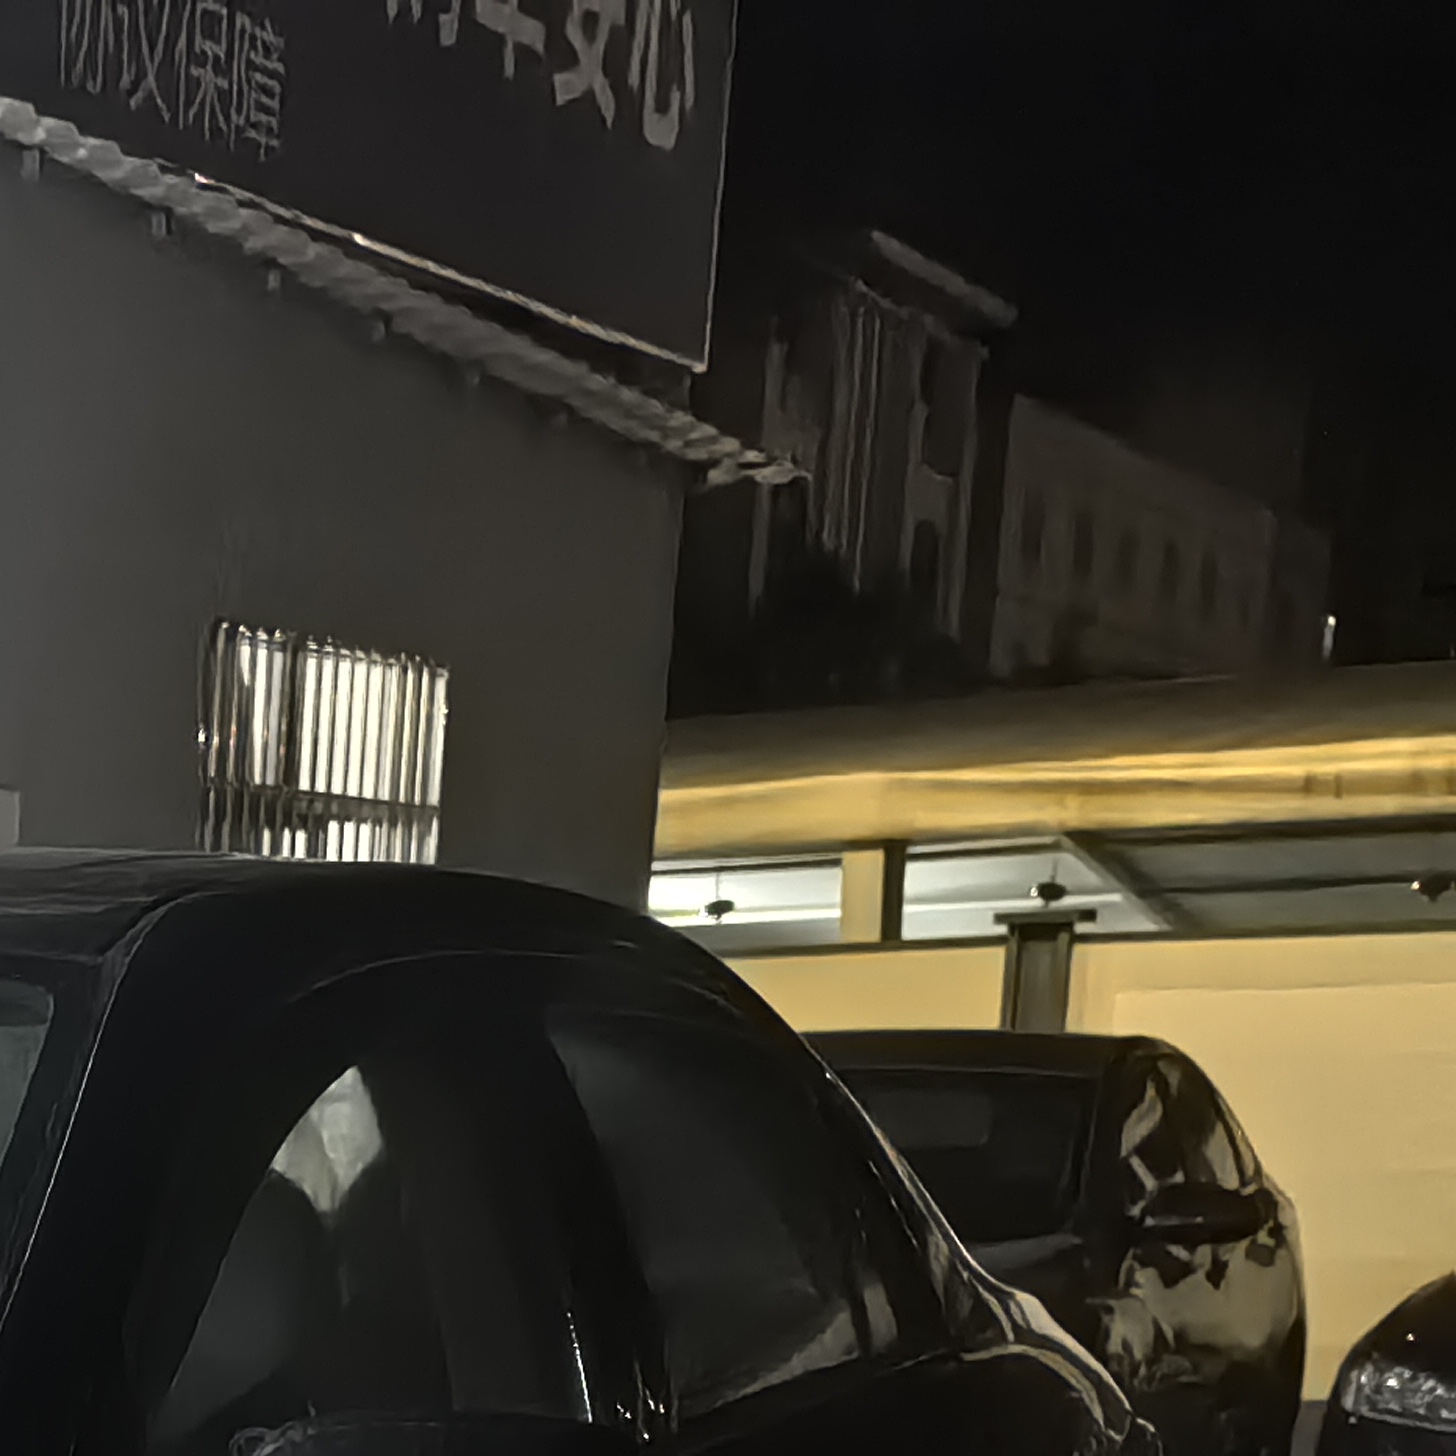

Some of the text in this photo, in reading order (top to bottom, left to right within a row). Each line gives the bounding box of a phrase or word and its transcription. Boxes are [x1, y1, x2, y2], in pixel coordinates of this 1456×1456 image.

[59, 0, 287, 161] 协议保障
[386, 0, 697, 150] 安心
